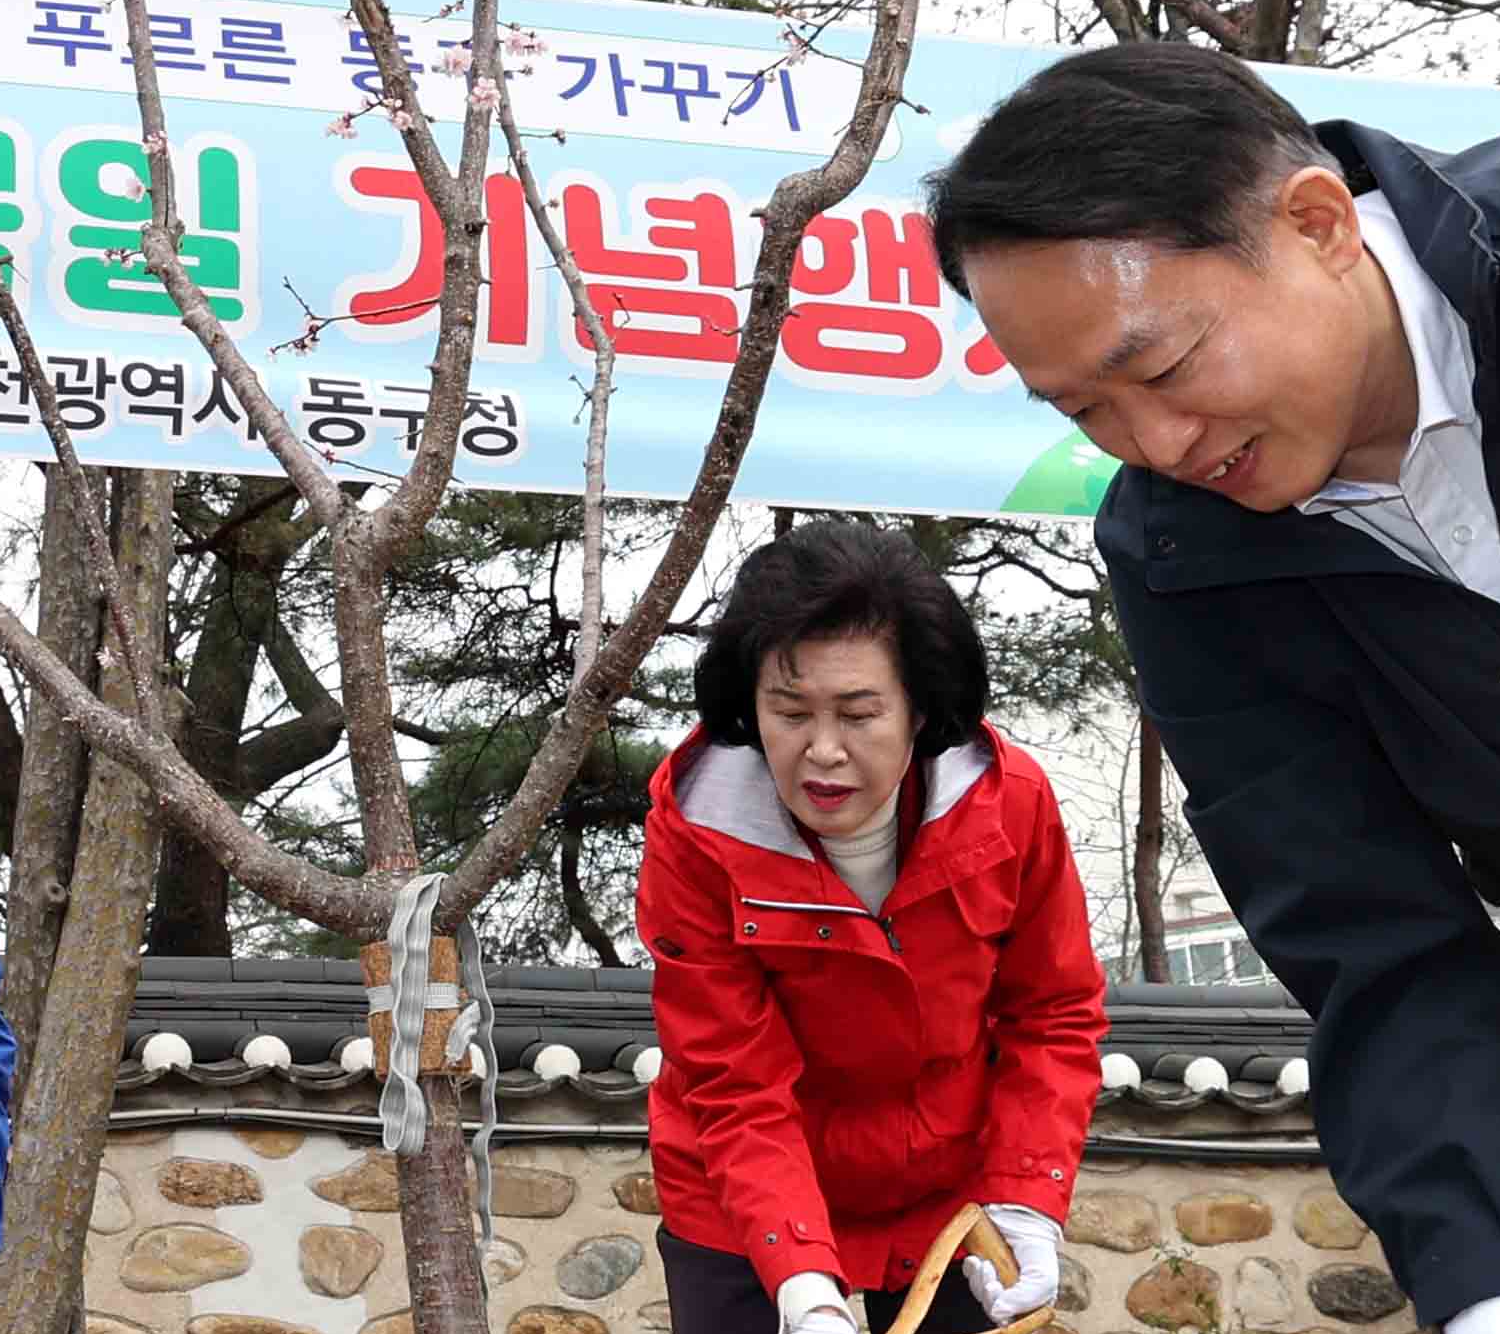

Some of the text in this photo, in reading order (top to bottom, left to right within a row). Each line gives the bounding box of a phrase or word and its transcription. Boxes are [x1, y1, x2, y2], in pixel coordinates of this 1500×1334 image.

[26, 0, 297, 85] 푸르른
[341, 30, 514, 94] 동
[555, 52, 801, 132] 가꾸기
[350, 166, 1011, 380] 기념행
[302, 377, 519, 457] 동구청
